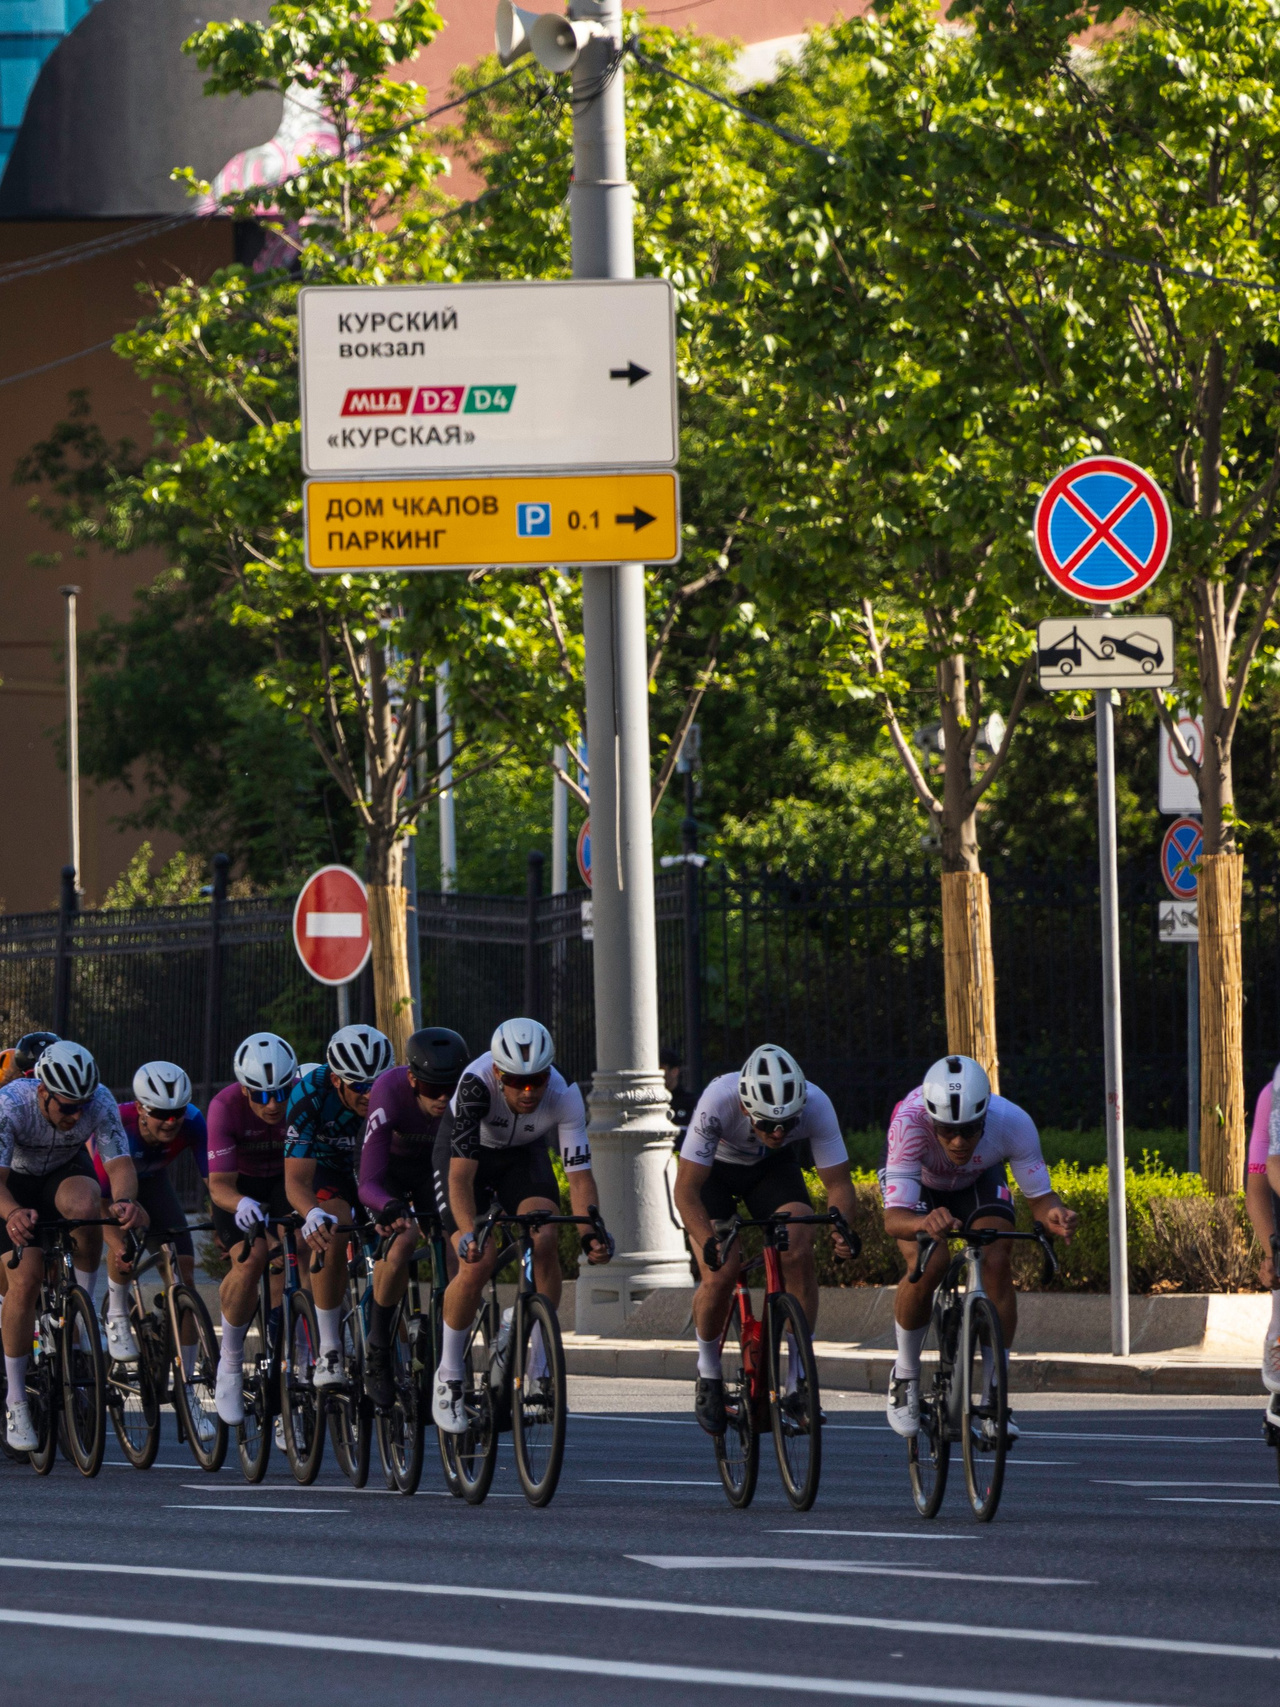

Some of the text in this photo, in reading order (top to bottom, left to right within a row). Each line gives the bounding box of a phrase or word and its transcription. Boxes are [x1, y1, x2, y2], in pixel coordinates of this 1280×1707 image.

[338, 306, 458, 333] КУРСКИЙ
[338, 341, 425, 358] вокзал
[348, 388, 508, 412] МЦД D2 D4
[327, 425, 475, 448] «КУРСКАЯ»
[325, 496, 498, 522] ДОМ ЧКАЛОВ
[567, 510, 600, 531] 0.1
[328, 530, 446, 551] ПАРКИНГ
[948, 1083, 962, 1091] 59
[773, 1107, 785, 1115] 67
